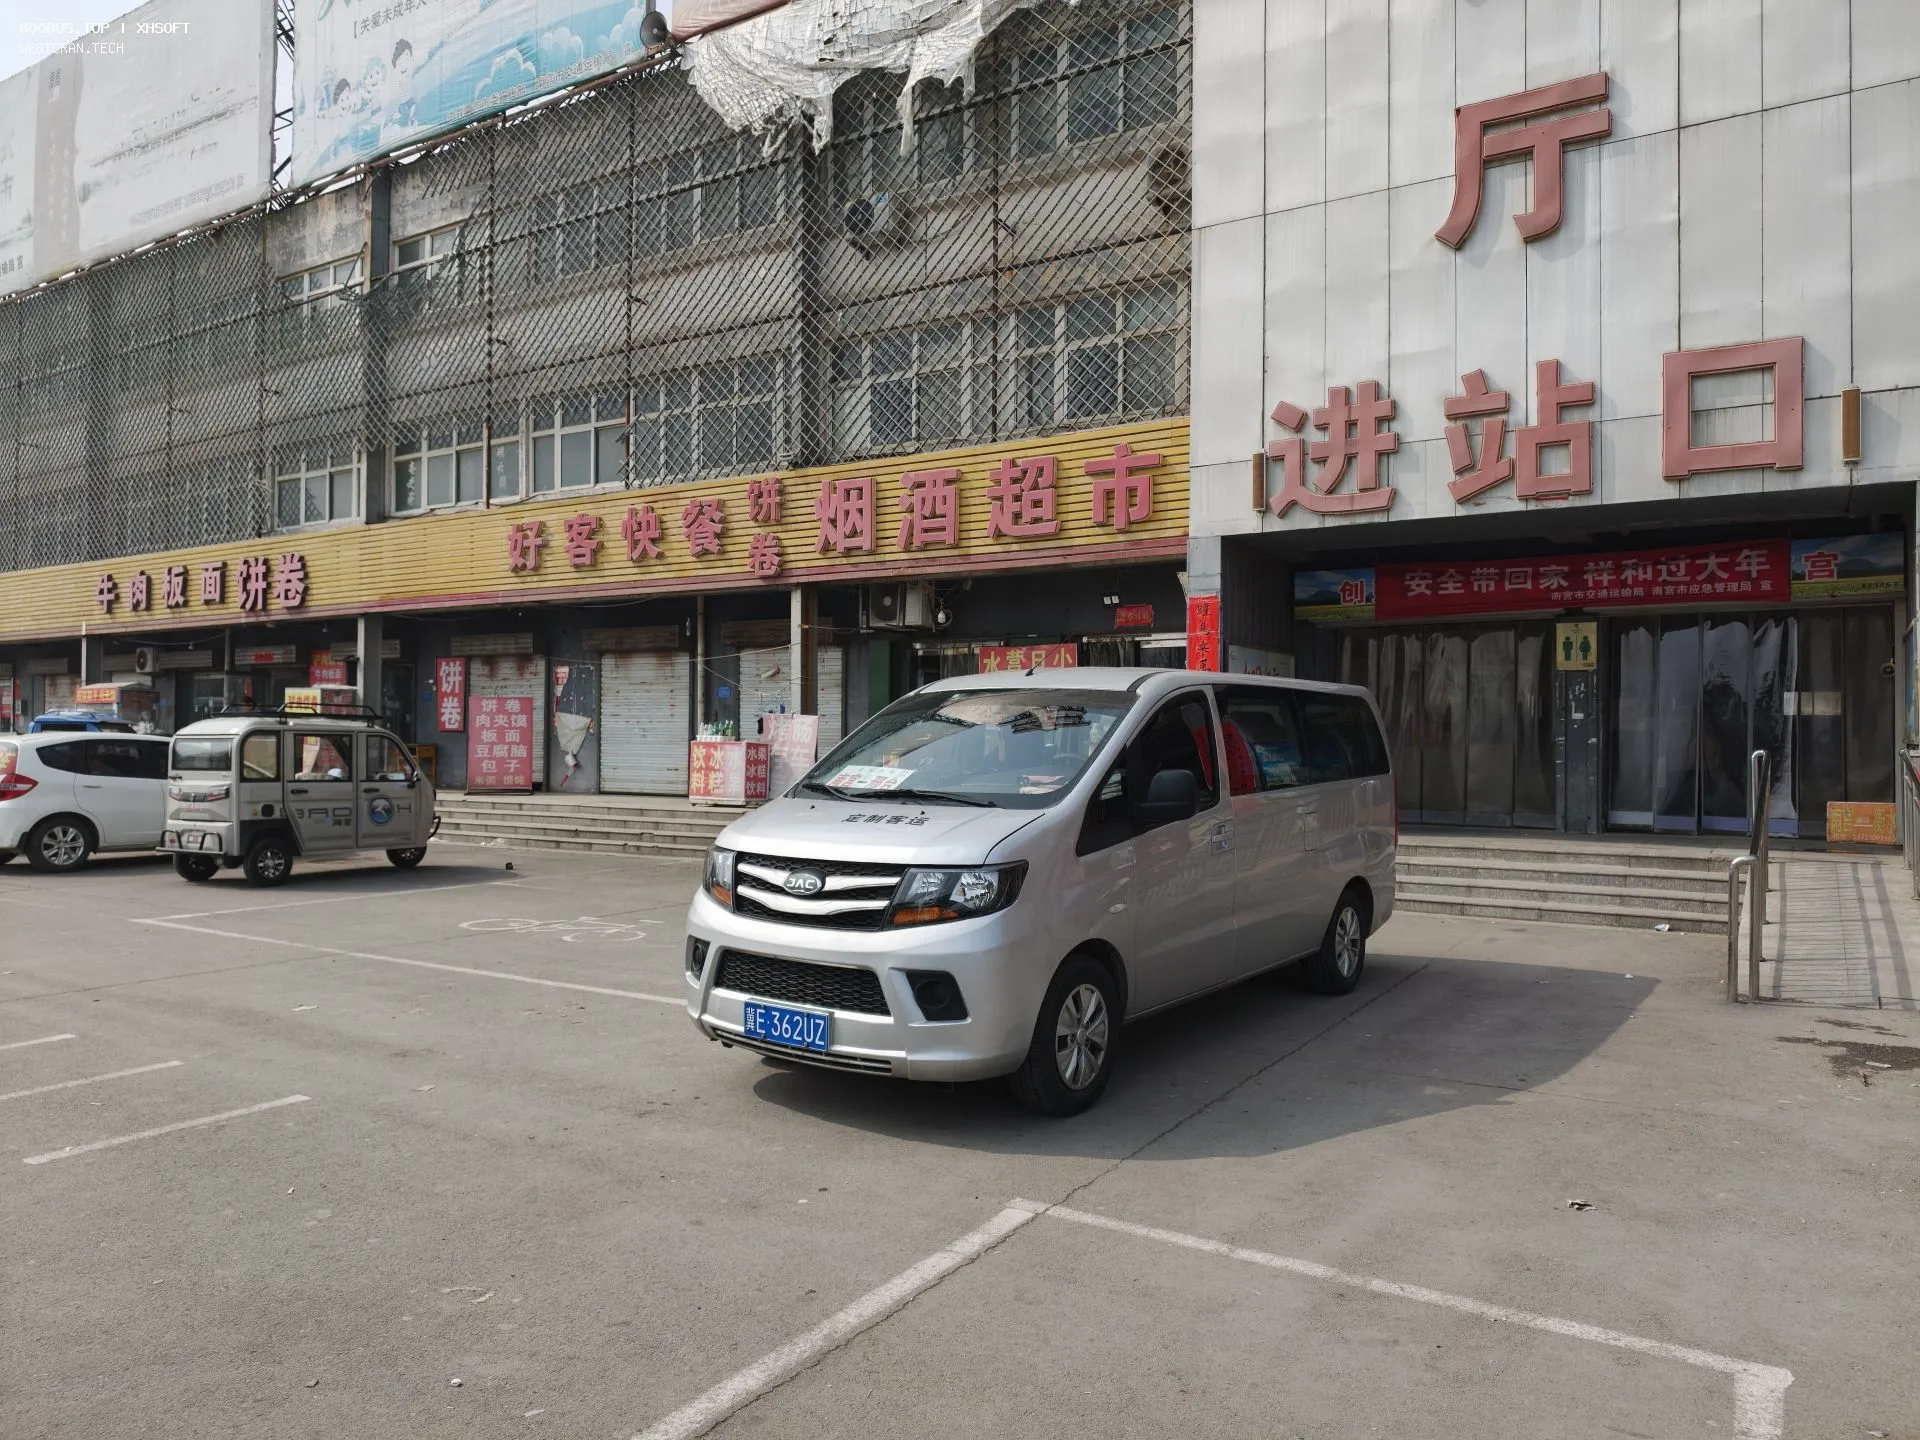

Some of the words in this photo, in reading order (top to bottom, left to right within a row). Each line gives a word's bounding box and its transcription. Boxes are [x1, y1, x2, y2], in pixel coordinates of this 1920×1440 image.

[1433, 70, 1613, 250] 厅
[1266, 335, 1805, 519] 进站口
[814, 443, 1165, 555] 烟酒超市
[506, 499, 726, 574] 好客快餐
[746, 477, 783, 579] 饼卷
[1403, 563, 1570, 597] 安全带回家
[1582, 547, 1772, 585] 祥和过大年
[1339, 578, 1376, 605] 创
[1551, 587, 1645, 601] 南宫市交通运输局
[1652, 580, 1752, 597] 南宫市应急管理局
[439, 661, 463, 730] 饼卷
[480, 699, 521, 713] 饼卷
[475, 714, 529, 728] 肉夹馍
[480, 729, 521, 744] 板面
[474, 744, 528, 759] 豆腐脑
[480, 759, 521, 773] 包子
[840, 812, 931, 826] 定制客运
[786, 877, 816, 889] JAC
[745, 1006, 825, 1047] 冀E·362UZ
